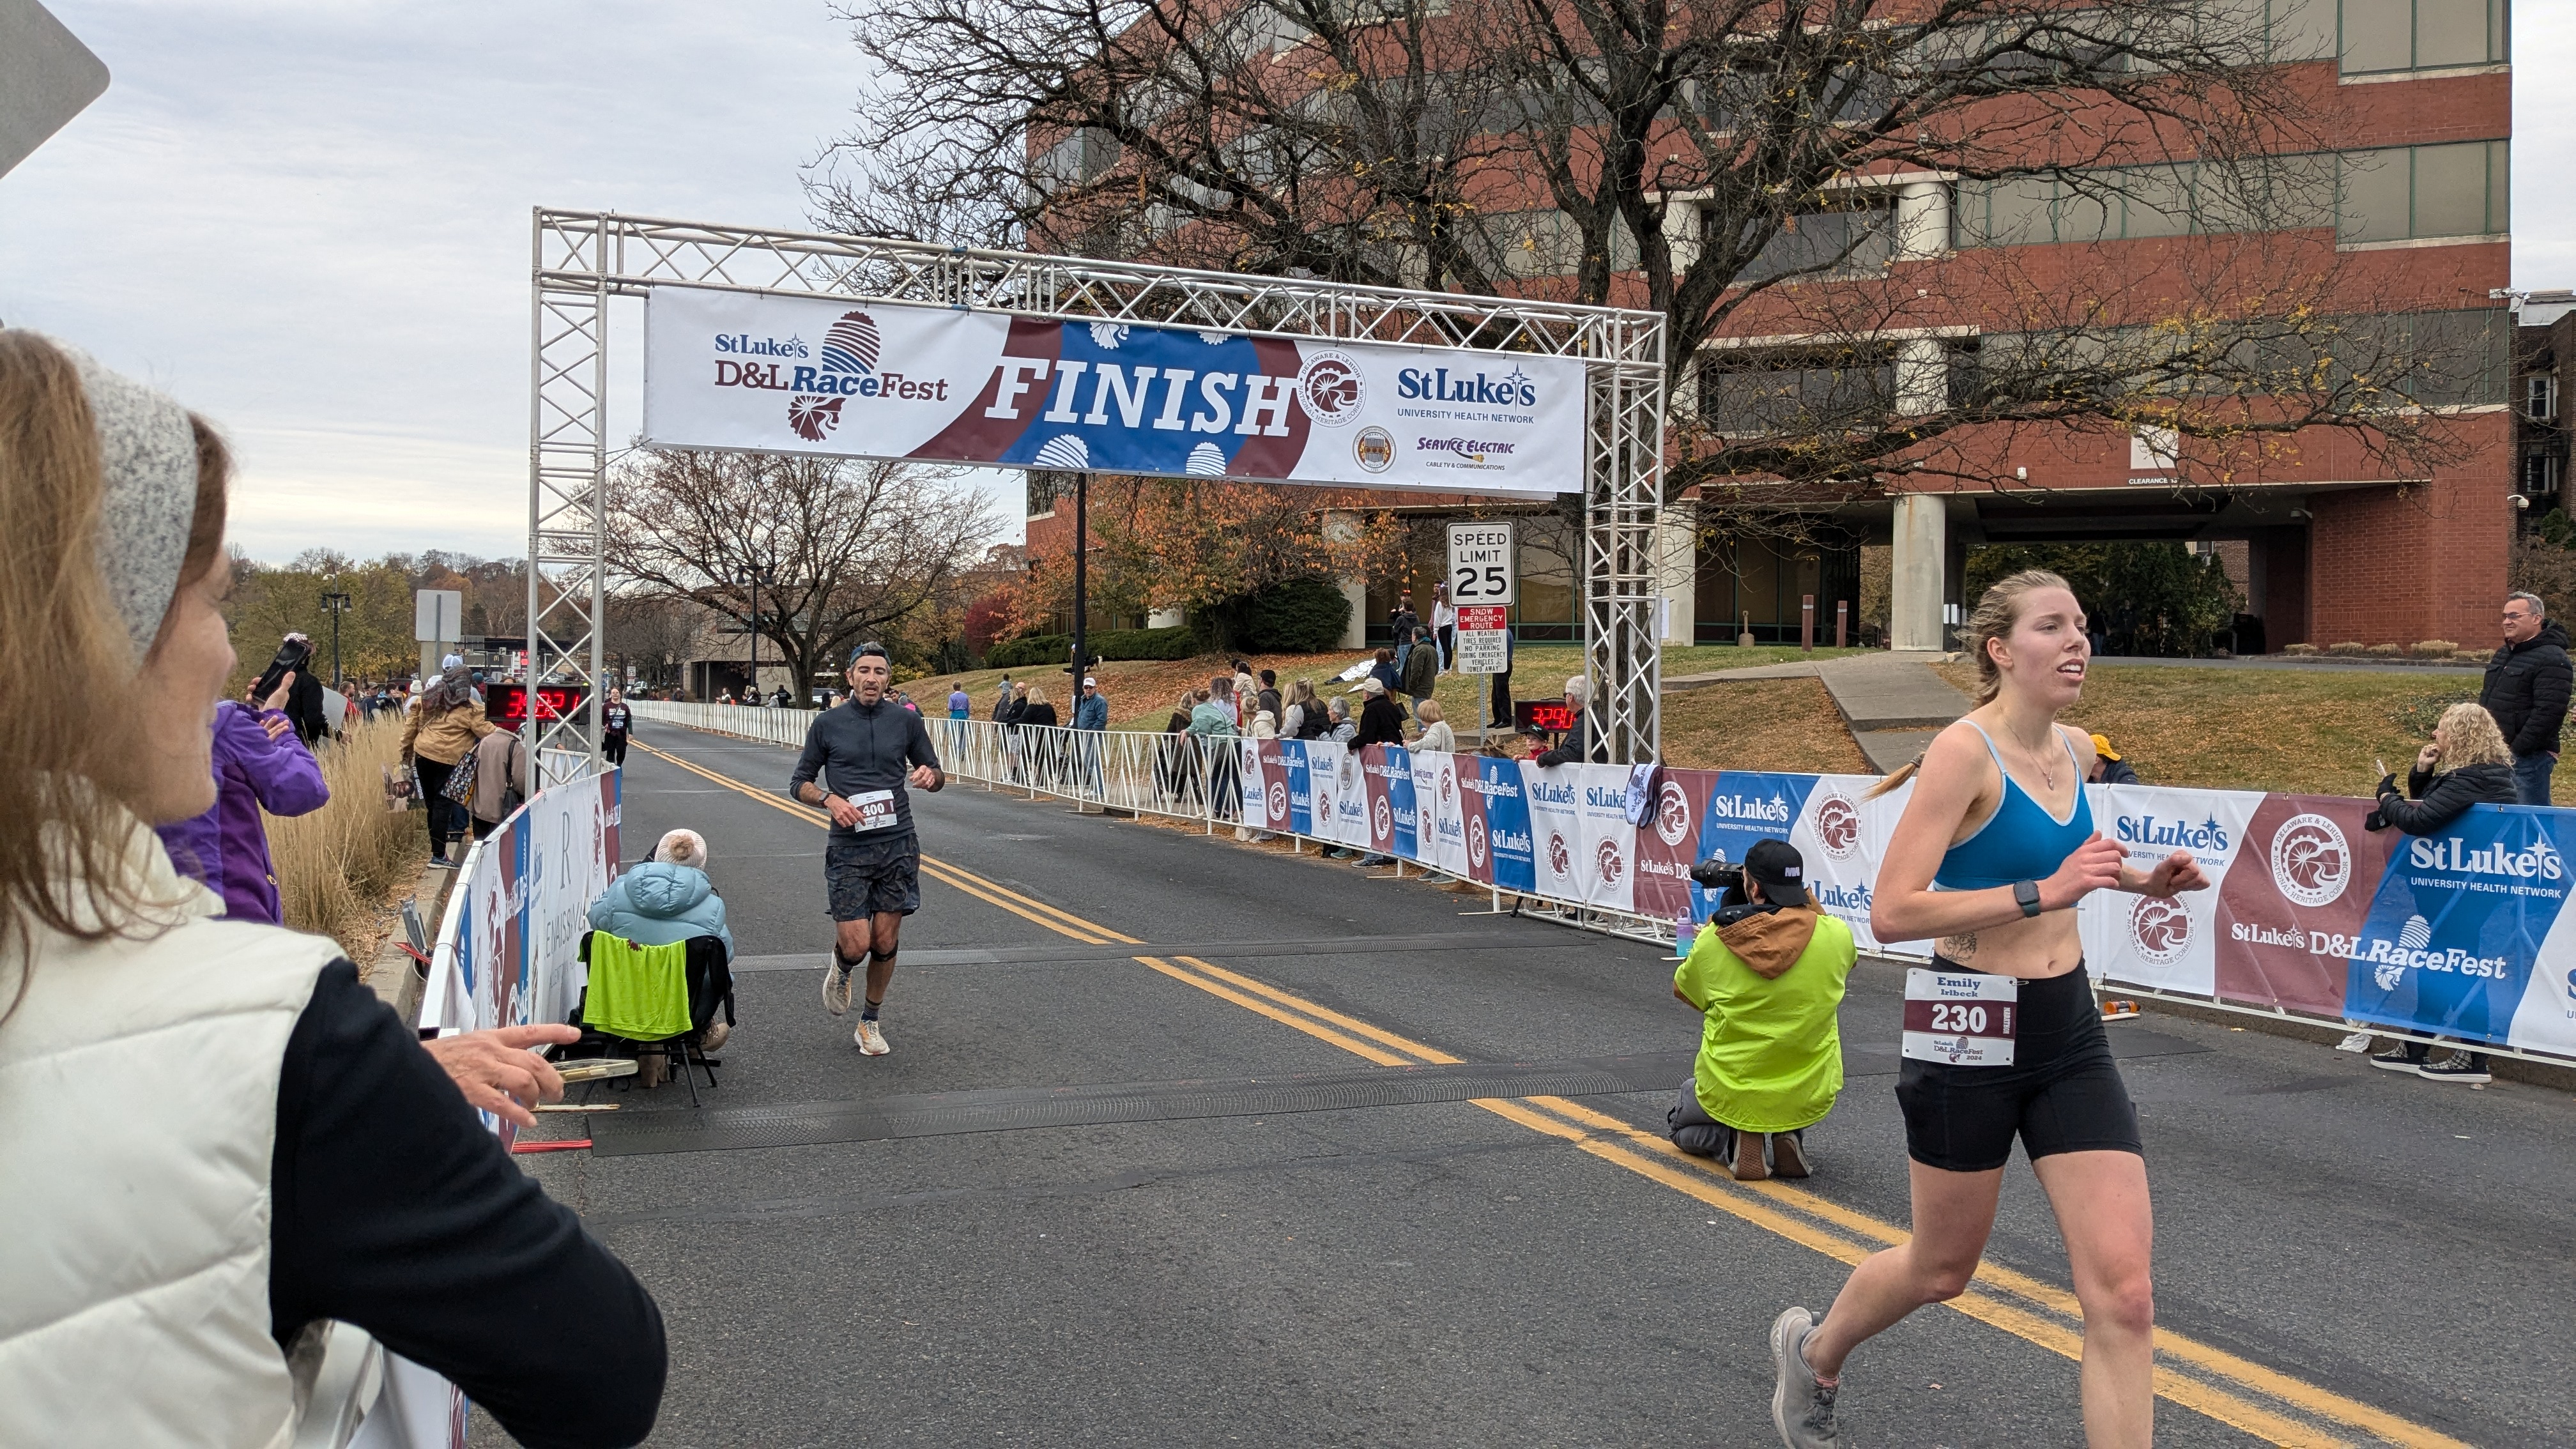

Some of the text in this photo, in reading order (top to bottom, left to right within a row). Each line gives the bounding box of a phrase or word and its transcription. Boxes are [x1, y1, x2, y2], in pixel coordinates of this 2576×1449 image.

[1301, 353, 1333, 375] DELAWARE
[1341, 356, 1361, 378] LEHIGH
[985, 356, 1298, 437] FINISH
[1299, 385, 1364, 425] NATIONAL HERITAGE CORRIDOR
[1397, 408, 1535, 424] UNIVERSITY HEALTH NETWORK
[1416, 437, 1515, 454] SERVICE ELECTRIC
[1456, 463, 1505, 471] COMMUNICATIONS
[1453, 533, 1506, 546] SPEED
[1460, 549, 1501, 563] LIMIT
[1455, 566, 1507, 597] 25
[1459, 615, 1503, 623] EMERGENCY
[862, 802, 885, 816] 400
[1816, 793, 1839, 815] DELAWARE
[1844, 795, 1860, 816] LEHIGH
[1716, 822, 1744, 831] UNIVERSITY
[1764, 826, 1789, 834] NETWORK
[2276, 816, 2312, 843] DELAWARE
[2321, 820, 2345, 848] LEHIGH
[1814, 824, 1862, 861] NATIONAL HERITAGE CORRIDOR
[2273, 855, 2349, 904] NATIONAL HERITAGE CORRIDOR
[2411, 877, 2561, 899] UNIVERSITY HEALTH NETWORK
[1846, 914, 1870, 924] NETWOR
[2126, 919, 2194, 965] NATIONAL HERITAGE CORRIDOR
[1937, 976, 1981, 990] Emily
[1940, 989, 1978, 997] Irlbeck
[1931, 1003, 1987, 1033] 230
